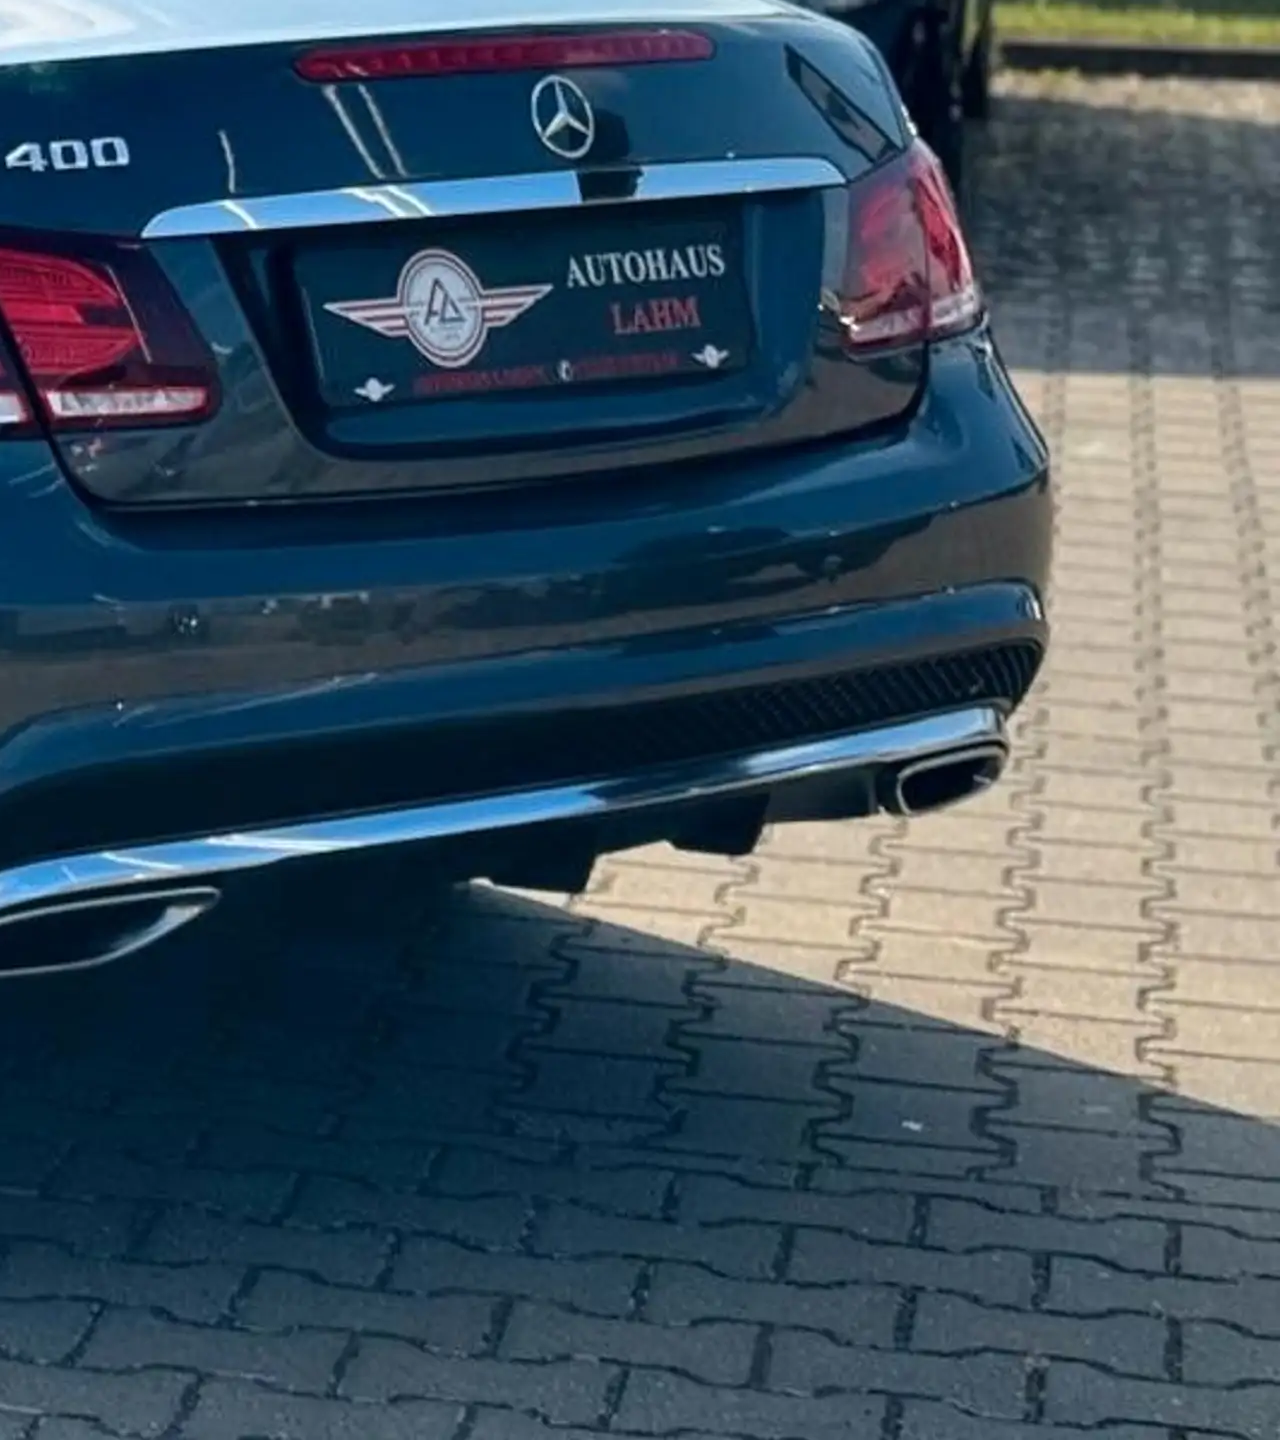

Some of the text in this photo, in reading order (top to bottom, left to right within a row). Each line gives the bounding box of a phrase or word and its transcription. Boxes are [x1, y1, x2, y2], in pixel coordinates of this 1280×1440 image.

[4, 136, 130, 172] 400
[566, 244, 726, 288] AUTOHAUS
[609, 295, 702, 335] LAHM
